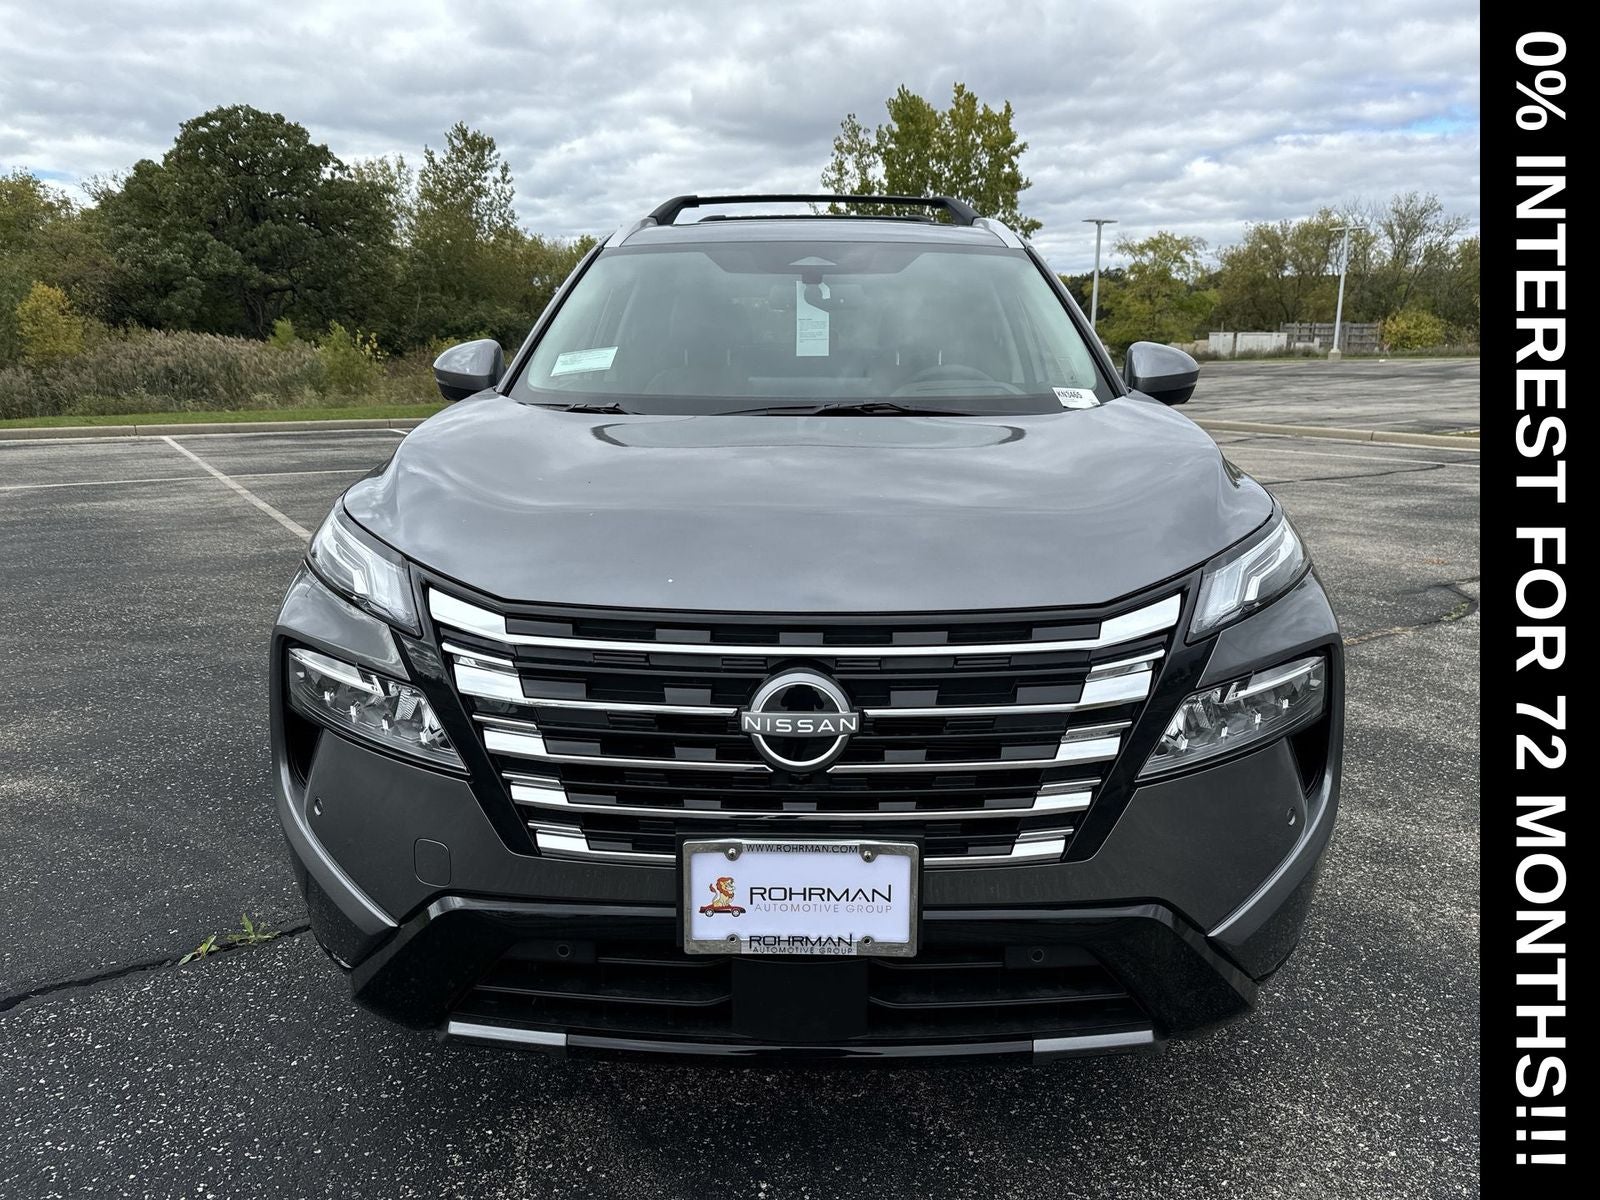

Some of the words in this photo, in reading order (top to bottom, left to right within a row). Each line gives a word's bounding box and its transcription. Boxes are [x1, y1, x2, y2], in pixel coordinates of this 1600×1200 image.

[744, 716, 857, 733] NISSAN
[746, 843, 859, 855] WWW.ROHRMAN.COM
[749, 884, 892, 905] ROHRMAN
[754, 904, 840, 913] AUTOMOTIVE
[845, 904, 892, 914] GROUP
[749, 934, 853, 949] ROHRMAN
[752, 946, 815, 954] AUTOMOTIVE
[818, 946, 854, 955] GROUP
